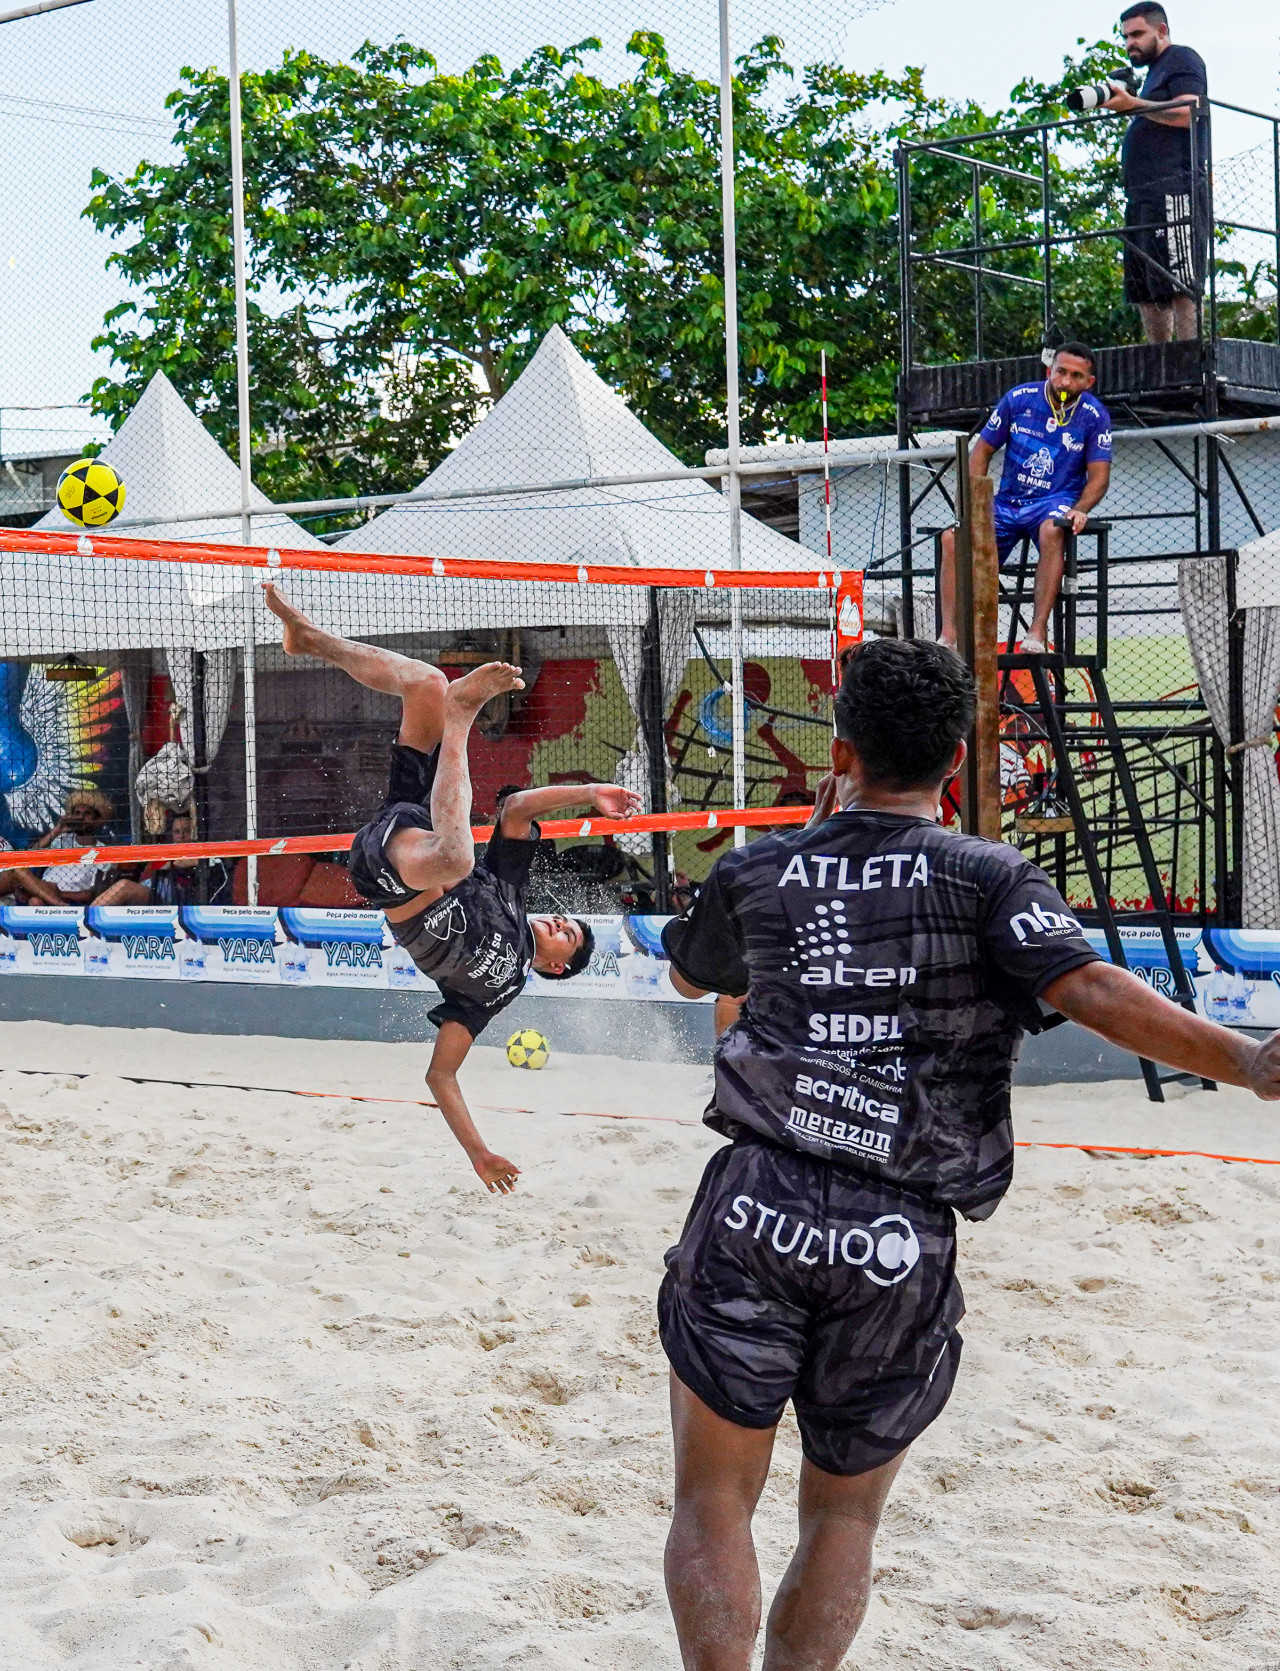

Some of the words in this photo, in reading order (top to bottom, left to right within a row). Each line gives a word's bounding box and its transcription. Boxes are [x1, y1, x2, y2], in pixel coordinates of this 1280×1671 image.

[1017, 473, 1026, 482] OS
[1027, 477, 1052, 489] MANOS
[777, 853, 928, 891] ATLETA
[1010, 902, 1083, 941] nbn
[1045, 927, 1077, 937] telecom
[1140, 930, 1160, 938] pelo
[28, 933, 81, 957] YARA
[121, 935, 176, 960] YARA
[218, 938, 276, 963] YARA
[491, 932, 502, 949] OS
[322, 941, 383, 968] YARA
[468, 948, 498, 979] MANOS
[581, 950, 620, 976] RA
[800, 960, 916, 986] aten
[808, 1013, 902, 1043] SEDEL
[800, 1056, 851, 1076] IMPRESSOS
[859, 1074, 903, 1094] CAMISARIA
[795, 1073, 899, 1124] acrítica
[788, 1106, 891, 1152] metazon
[866, 1153, 888, 1164] METAIS
[724, 1194, 874, 1266] STUDIO
